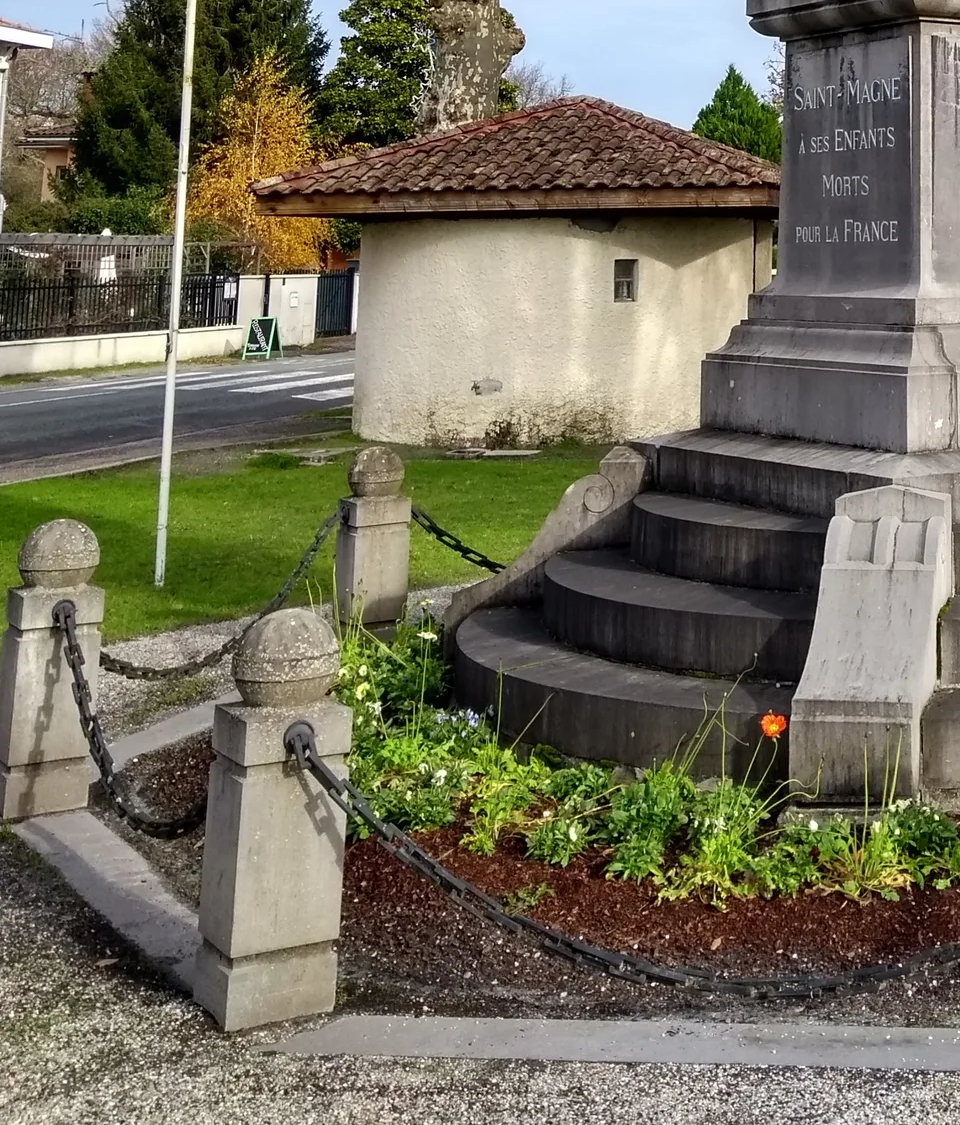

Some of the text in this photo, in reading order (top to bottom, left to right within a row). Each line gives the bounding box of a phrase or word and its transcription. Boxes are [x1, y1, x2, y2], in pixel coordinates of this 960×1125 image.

[810, 136, 830, 153] SES
[835, 126, 896, 152] ENFANTS
[822, 174, 870, 197] MORTS
[795, 219, 899, 243] POUR LA FRANCE
